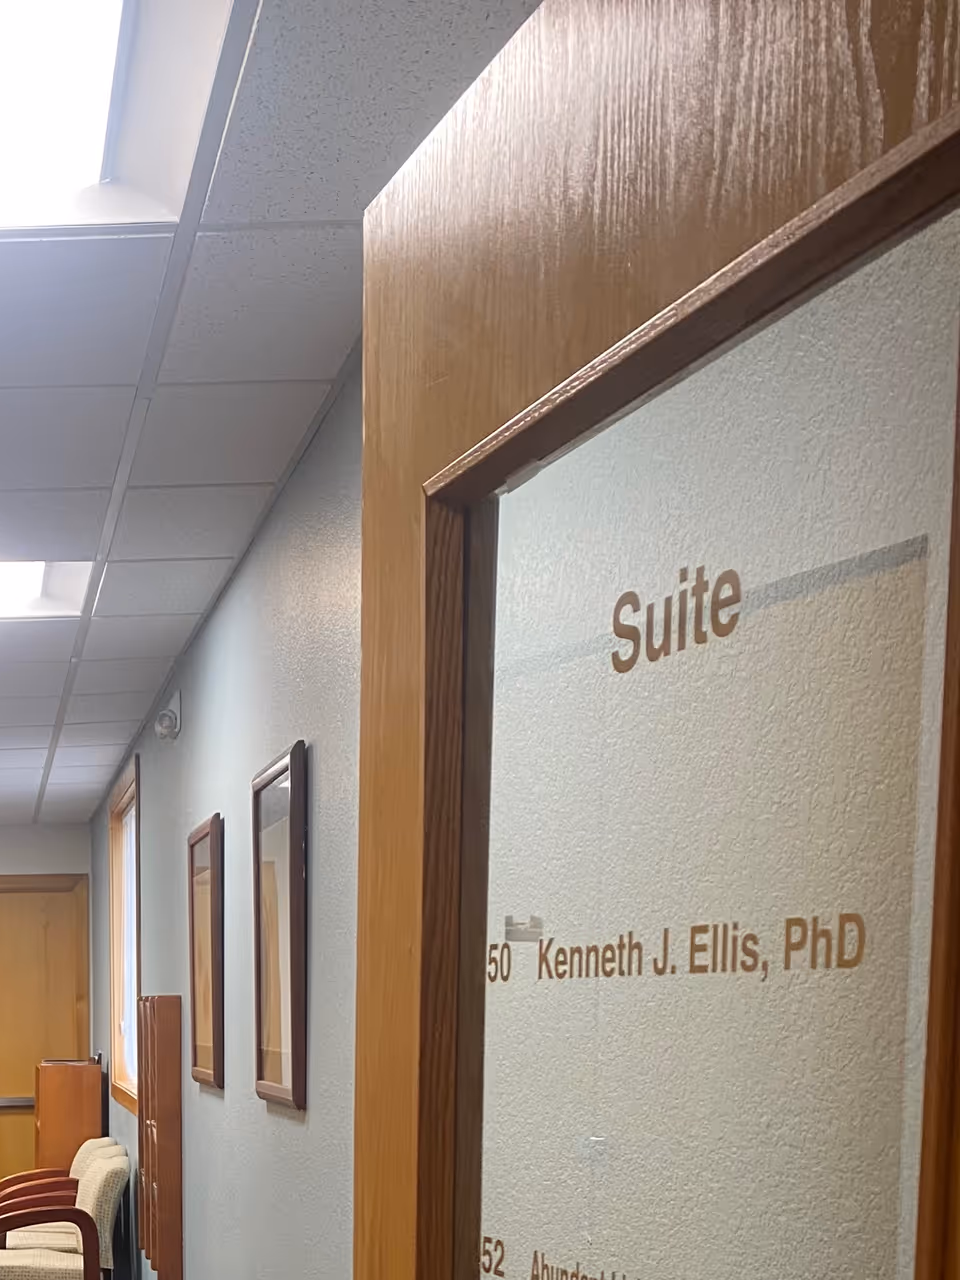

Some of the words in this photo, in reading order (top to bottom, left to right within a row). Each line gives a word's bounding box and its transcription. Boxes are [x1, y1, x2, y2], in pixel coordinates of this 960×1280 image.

[611, 565, 742, 674] Suite
[487, 942, 512, 982] 50
[538, 930, 643, 980] Kenneth
[653, 927, 676, 976] J.
[689, 921, 768, 982] Ellis,
[784, 913, 866, 970] PhD
[481, 1236, 506, 1278] 52
